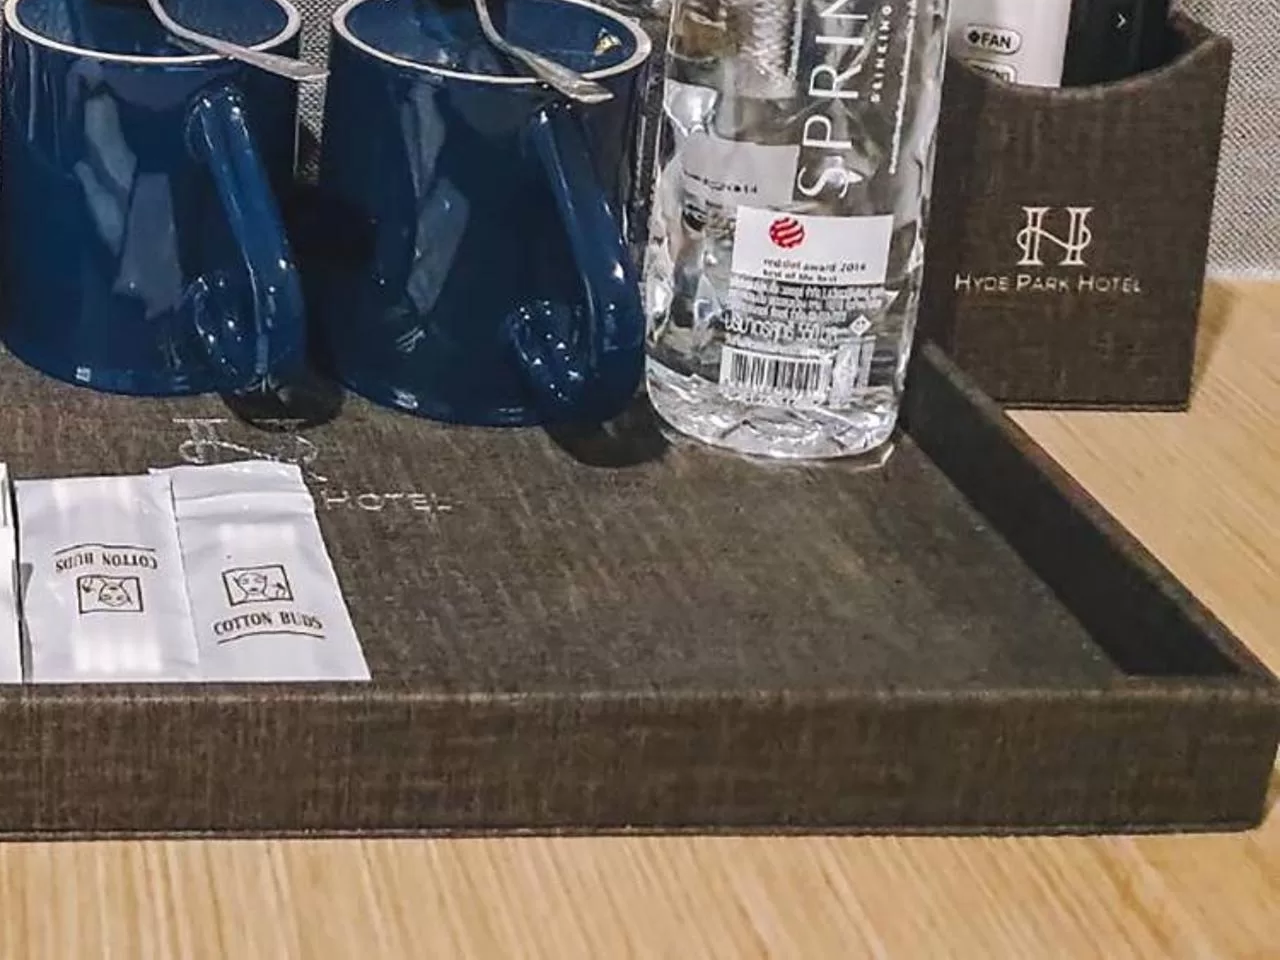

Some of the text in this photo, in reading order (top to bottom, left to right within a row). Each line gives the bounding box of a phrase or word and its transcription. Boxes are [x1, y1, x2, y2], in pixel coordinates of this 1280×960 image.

[980, 33, 1012, 49] FAN
[1016, 273, 1069, 292] PARK
[1078, 274, 1142, 293] HOTEL
[55, 551, 158, 572] COTTON BUDS
[213, 611, 324, 635] COTTON BUDS
